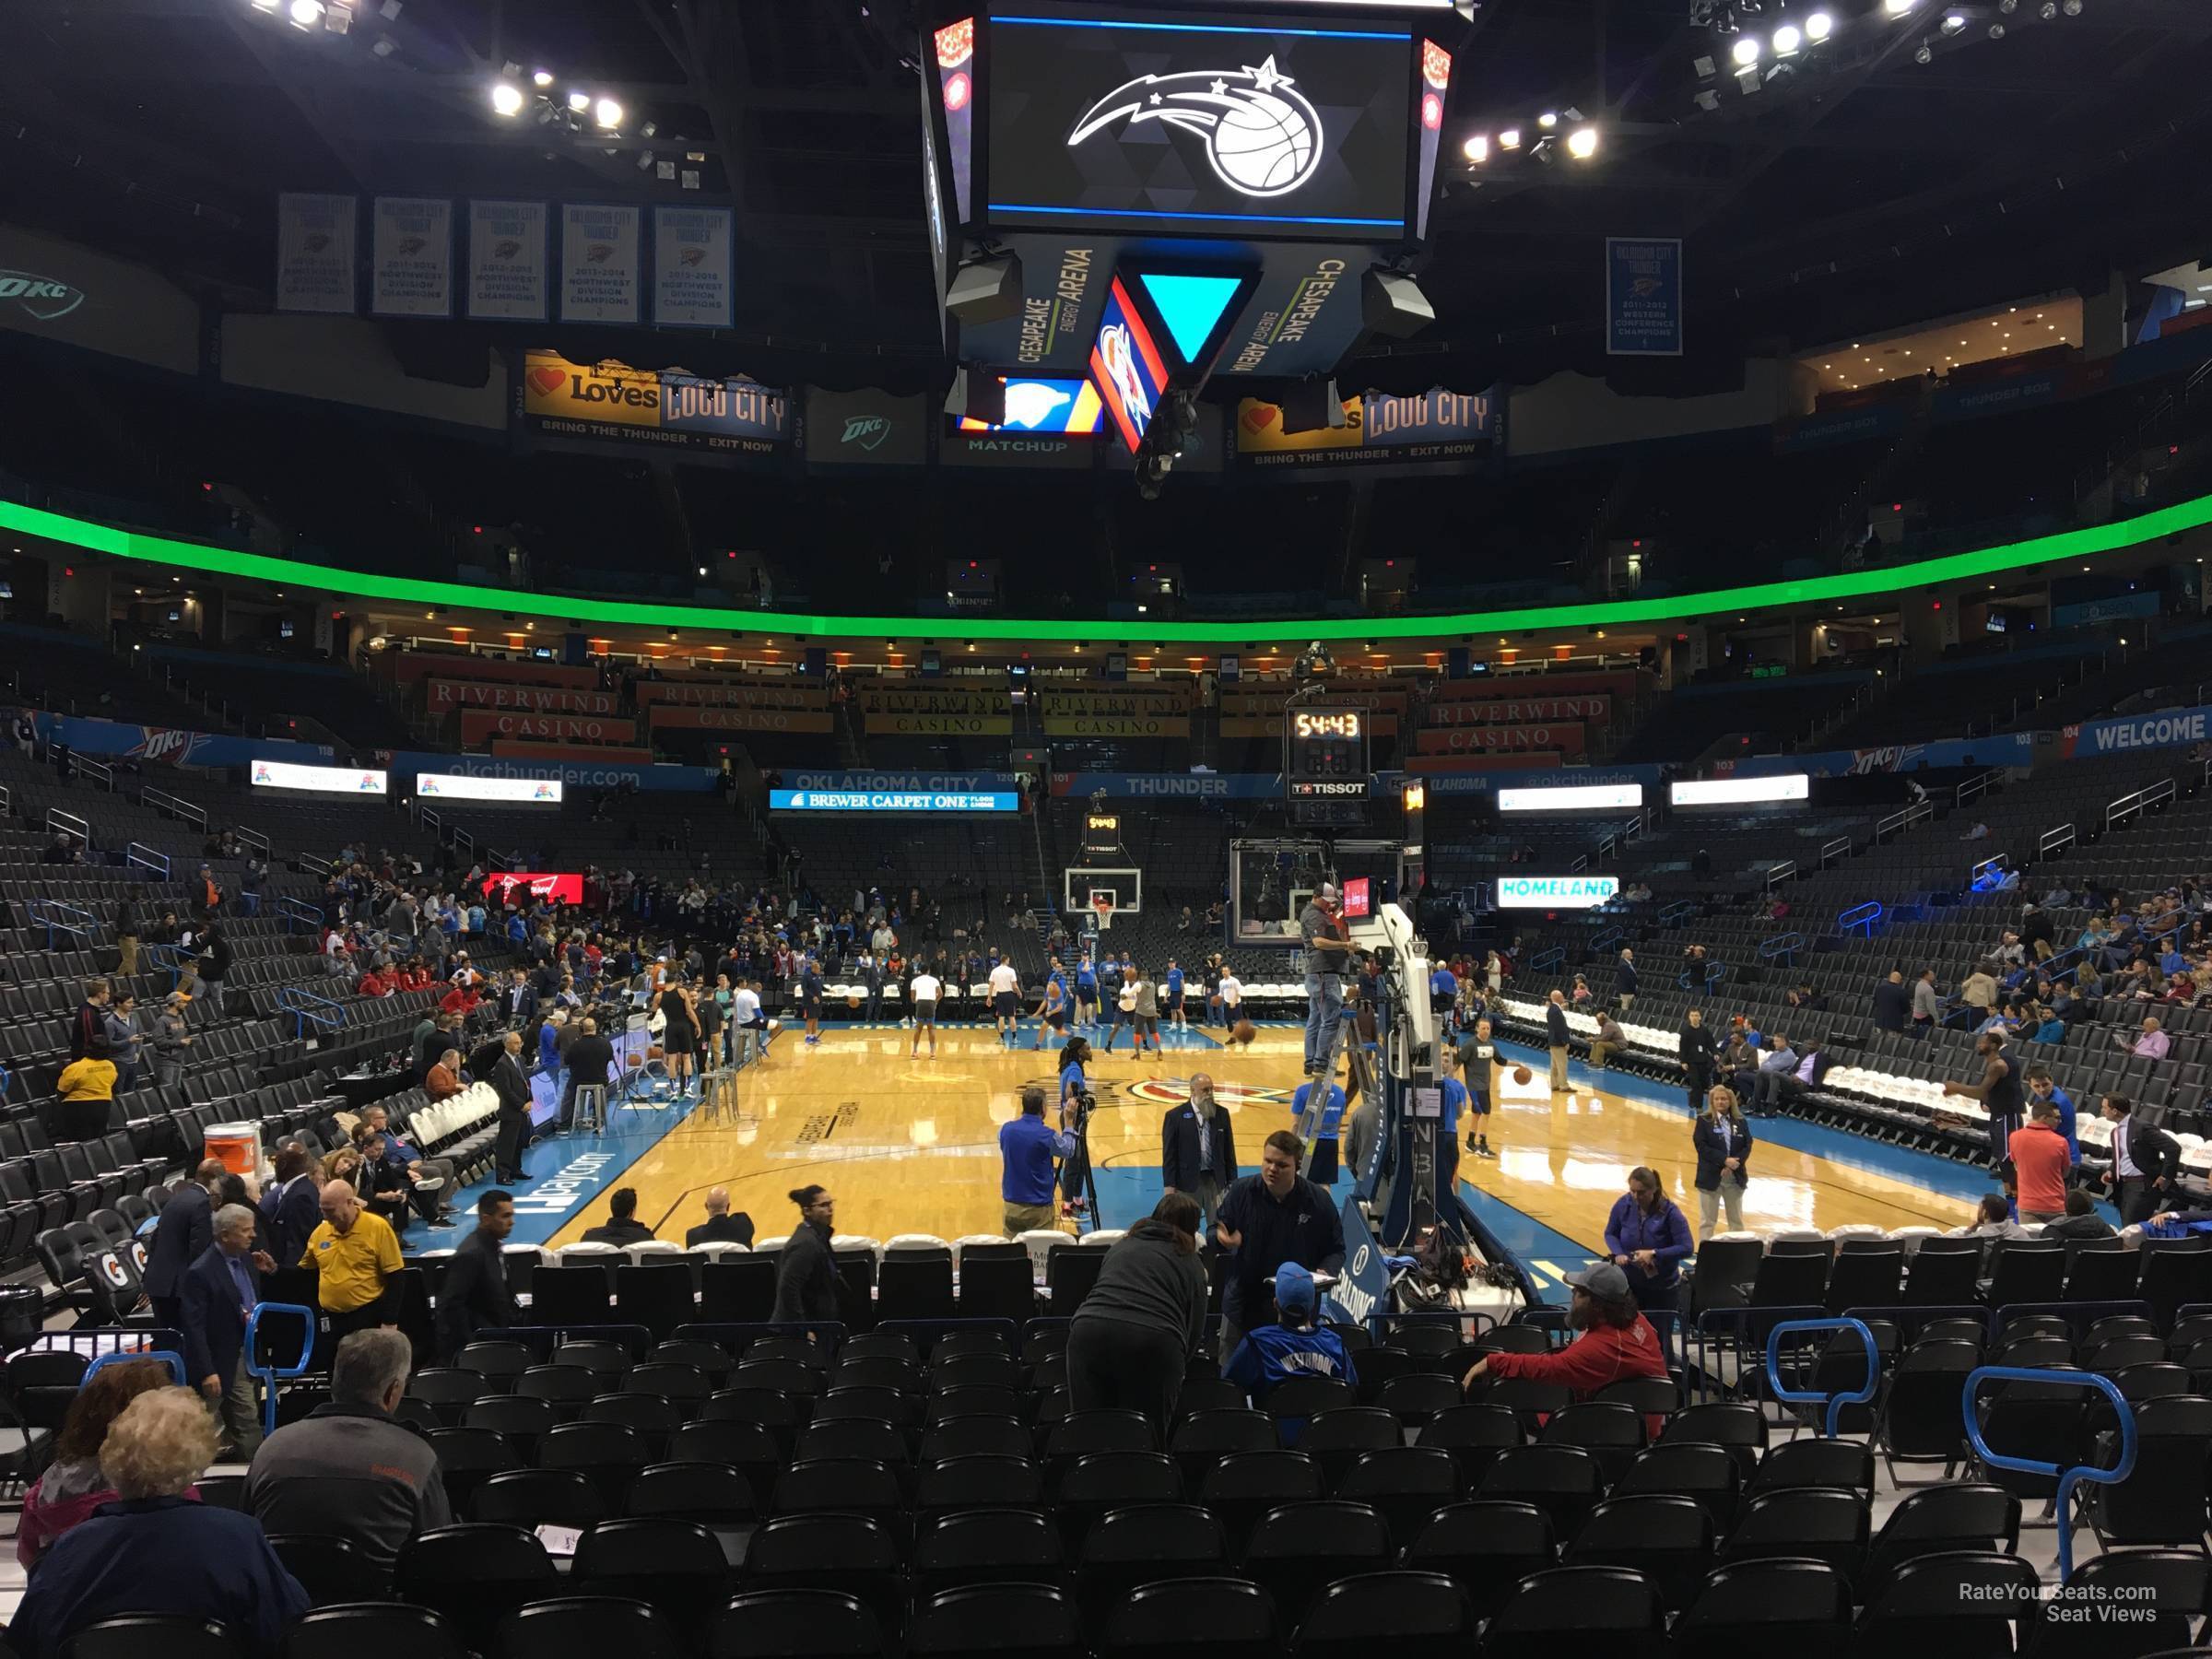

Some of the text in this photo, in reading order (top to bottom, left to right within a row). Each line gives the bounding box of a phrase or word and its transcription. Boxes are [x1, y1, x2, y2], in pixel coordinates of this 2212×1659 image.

[380, 271, 442, 279] NORTHWEST
[476, 275, 537, 283] NORTHWEST
[569, 278, 630, 287] NORTHWEST
[389, 280, 433, 288] DIVISION
[486, 283, 530, 291] DIVISION
[577, 288, 622, 296] DIVISION
[662, 281, 723, 290] NORTHWEST
[1056, 249, 1094, 333] ENERGY ARENA
[382, 289, 442, 299] CHAMPIONS
[477, 292, 536, 300] CHAMPIONS
[570, 296, 629, 305] CHAMPIONS
[670, 290, 715, 300] DIVISION
[1277, 259, 1346, 342] CHESAPEAKE
[663, 300, 723, 309] CHAMPIONS
[1018, 298, 1051, 362] CHESAPEAKE
[1615, 319, 1675, 327] CONFERENCE
[1618, 328, 1672, 336] CHAMPIONS
[1230, 312, 1279, 371] ENERGY ARENA
[1959, 382, 2051, 407] THUNDER BOX
[667, 382, 784, 432] LOUD CITY
[1369, 392, 1429, 439] LOUD
[1437, 390, 1488, 431] CITY
[542, 420, 688, 443] BRING THE THUNDER
[840, 418, 884, 442] OKC
[709, 437, 772, 453] EXIT NOW
[968, 440, 1069, 453] MATCHUP
[1409, 442, 1475, 458] EXIT NOW
[1253, 449, 1390, 465] BRING THE THUNDER
[435, 684, 610, 712] RIVERWIND
[665, 688, 804, 705] RIVERWIND
[870, 694, 1004, 710] RIVERWIND
[1050, 697, 1182, 711] RIVERWIND
[1437, 700, 1605, 723] RIVERWIND
[498, 716, 603, 738] CASINO
[699, 712, 788, 728] CASINO
[897, 718, 982, 732] CASINO
[1075, 721, 1159, 734] CASINO
[1297, 713, 1358, 737] 54:43
[1449, 728, 1550, 748] CASINO
[2016, 733, 2031, 745] 103
[2062, 725, 2079, 738] 104
[2095, 713, 2206, 750] WELCOME
[144, 729, 183, 760] OKC
[1716, 759, 1735, 771] 103
[449, 760, 641, 787] okcthunder.com
[996, 773, 1015, 782] 120
[1053, 774, 1068, 782] 101
[1525, 772, 1635, 789] @okcthunder
[796, 774, 979, 792] OKLAHOMA CITY
[1126, 778, 1229, 794] THUNDER
[1430, 777, 1487, 791] KLAHOMA
[809, 794, 966, 808] BREWER CARPET ONE
[1503, 880, 1615, 897] HOMELAND
[1368, 1057, 1384, 1175] DRAFTKINGS
[528, 1152, 616, 1197] paycom
[1330, 1266, 1377, 1328] SPALDING
